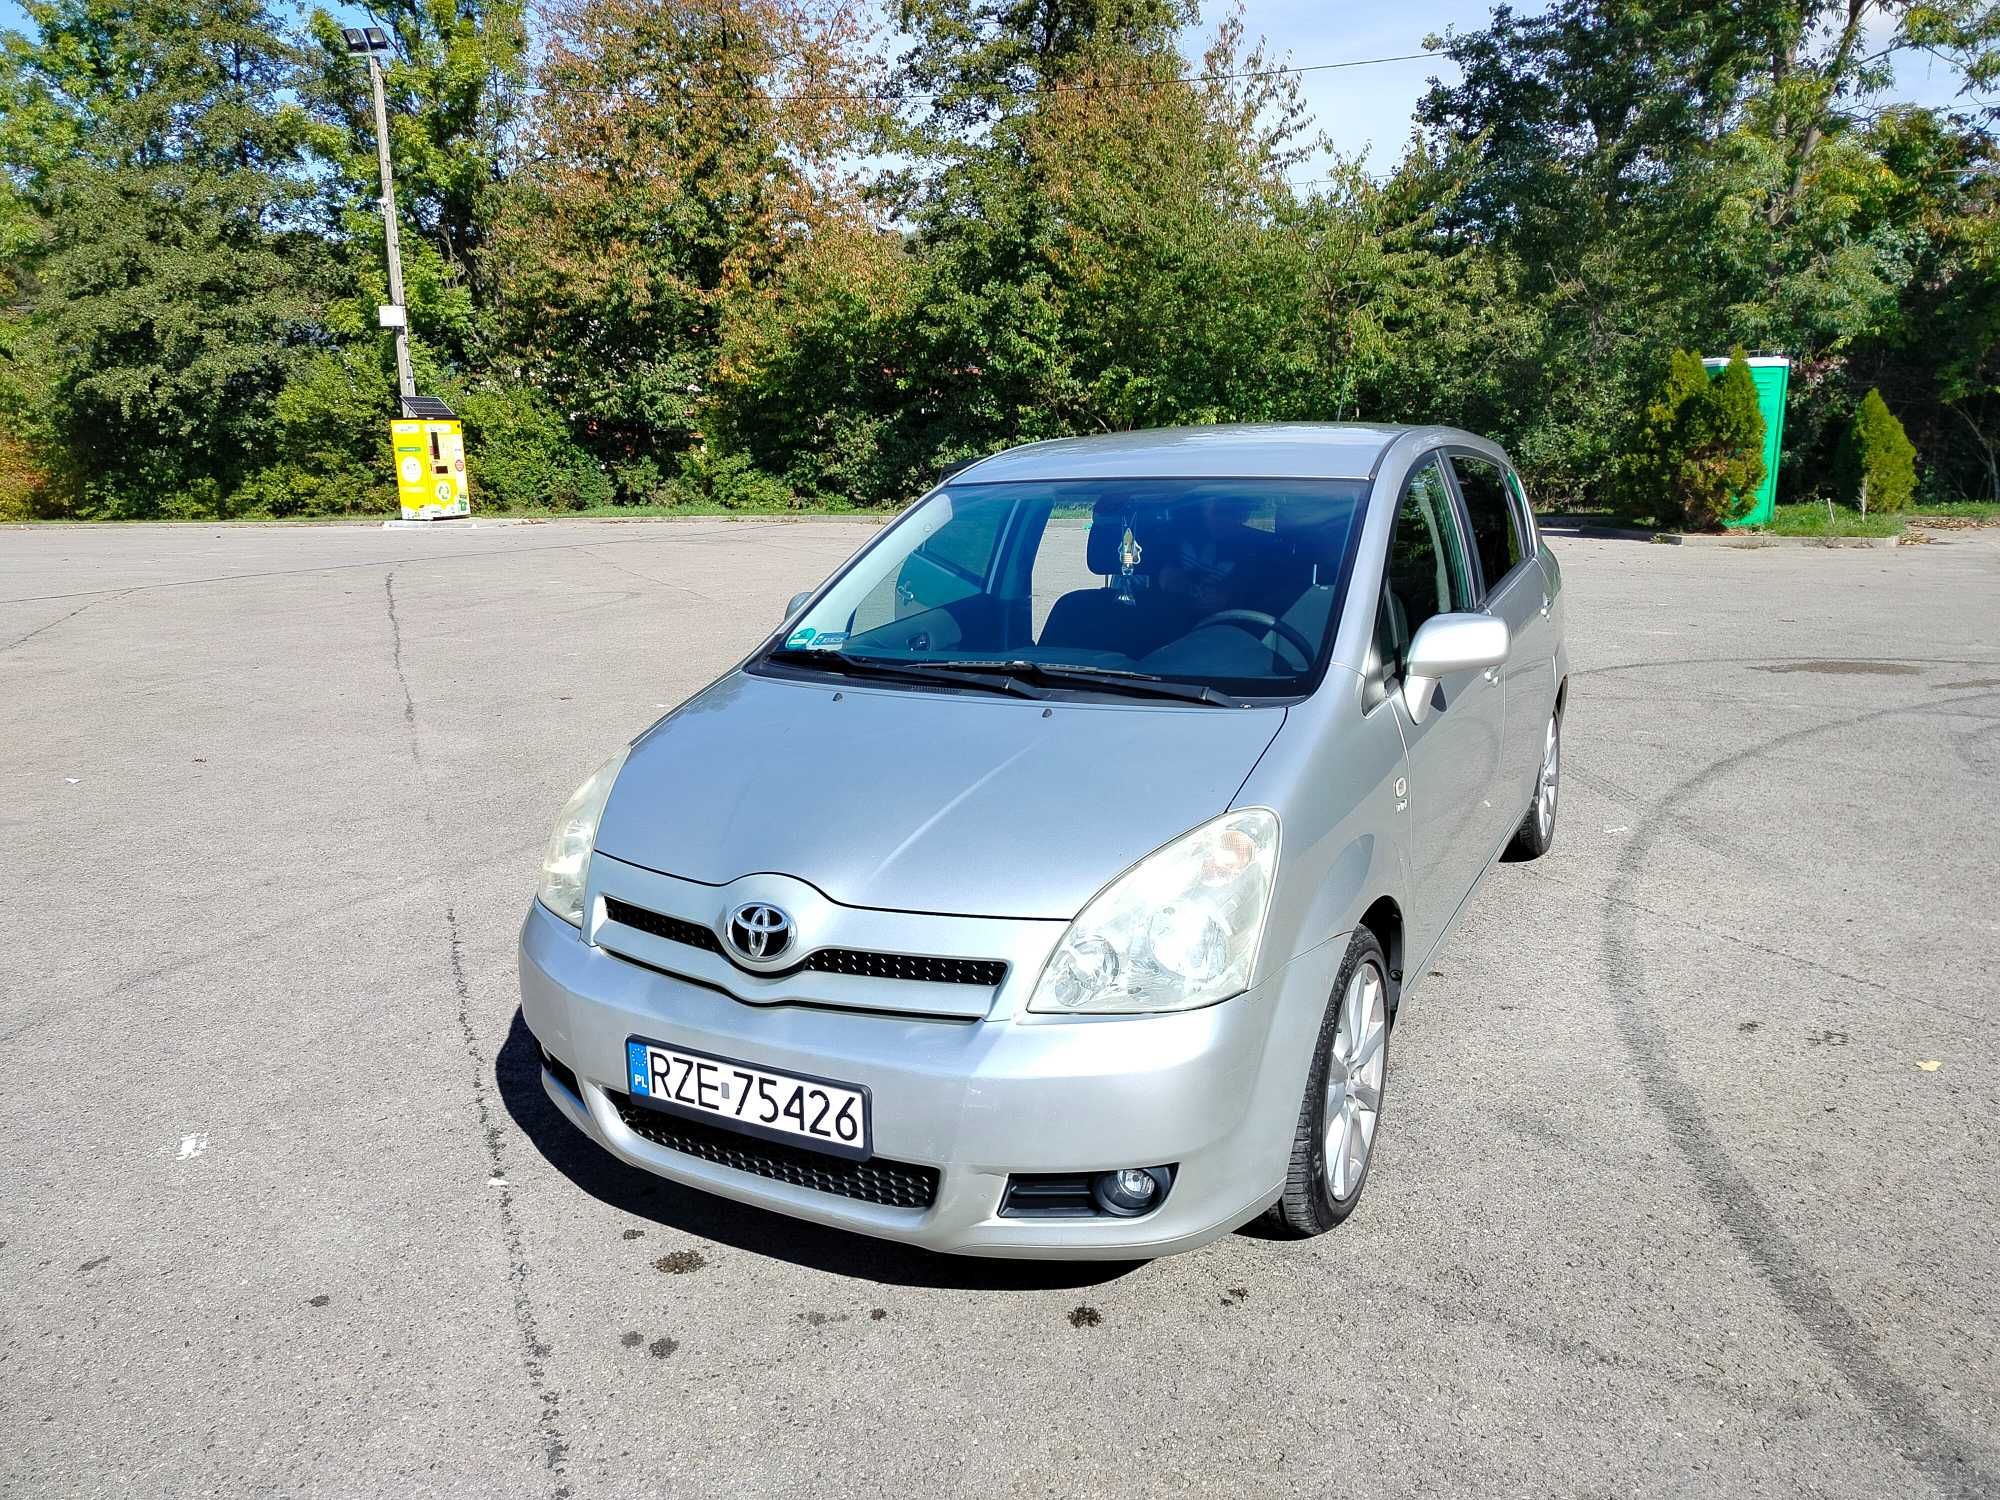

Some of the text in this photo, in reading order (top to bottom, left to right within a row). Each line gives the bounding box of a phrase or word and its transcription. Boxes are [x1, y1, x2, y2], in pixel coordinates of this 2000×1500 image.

[634, 1073, 648, 1088] PL
[649, 1051, 858, 1142] RZE 75426
